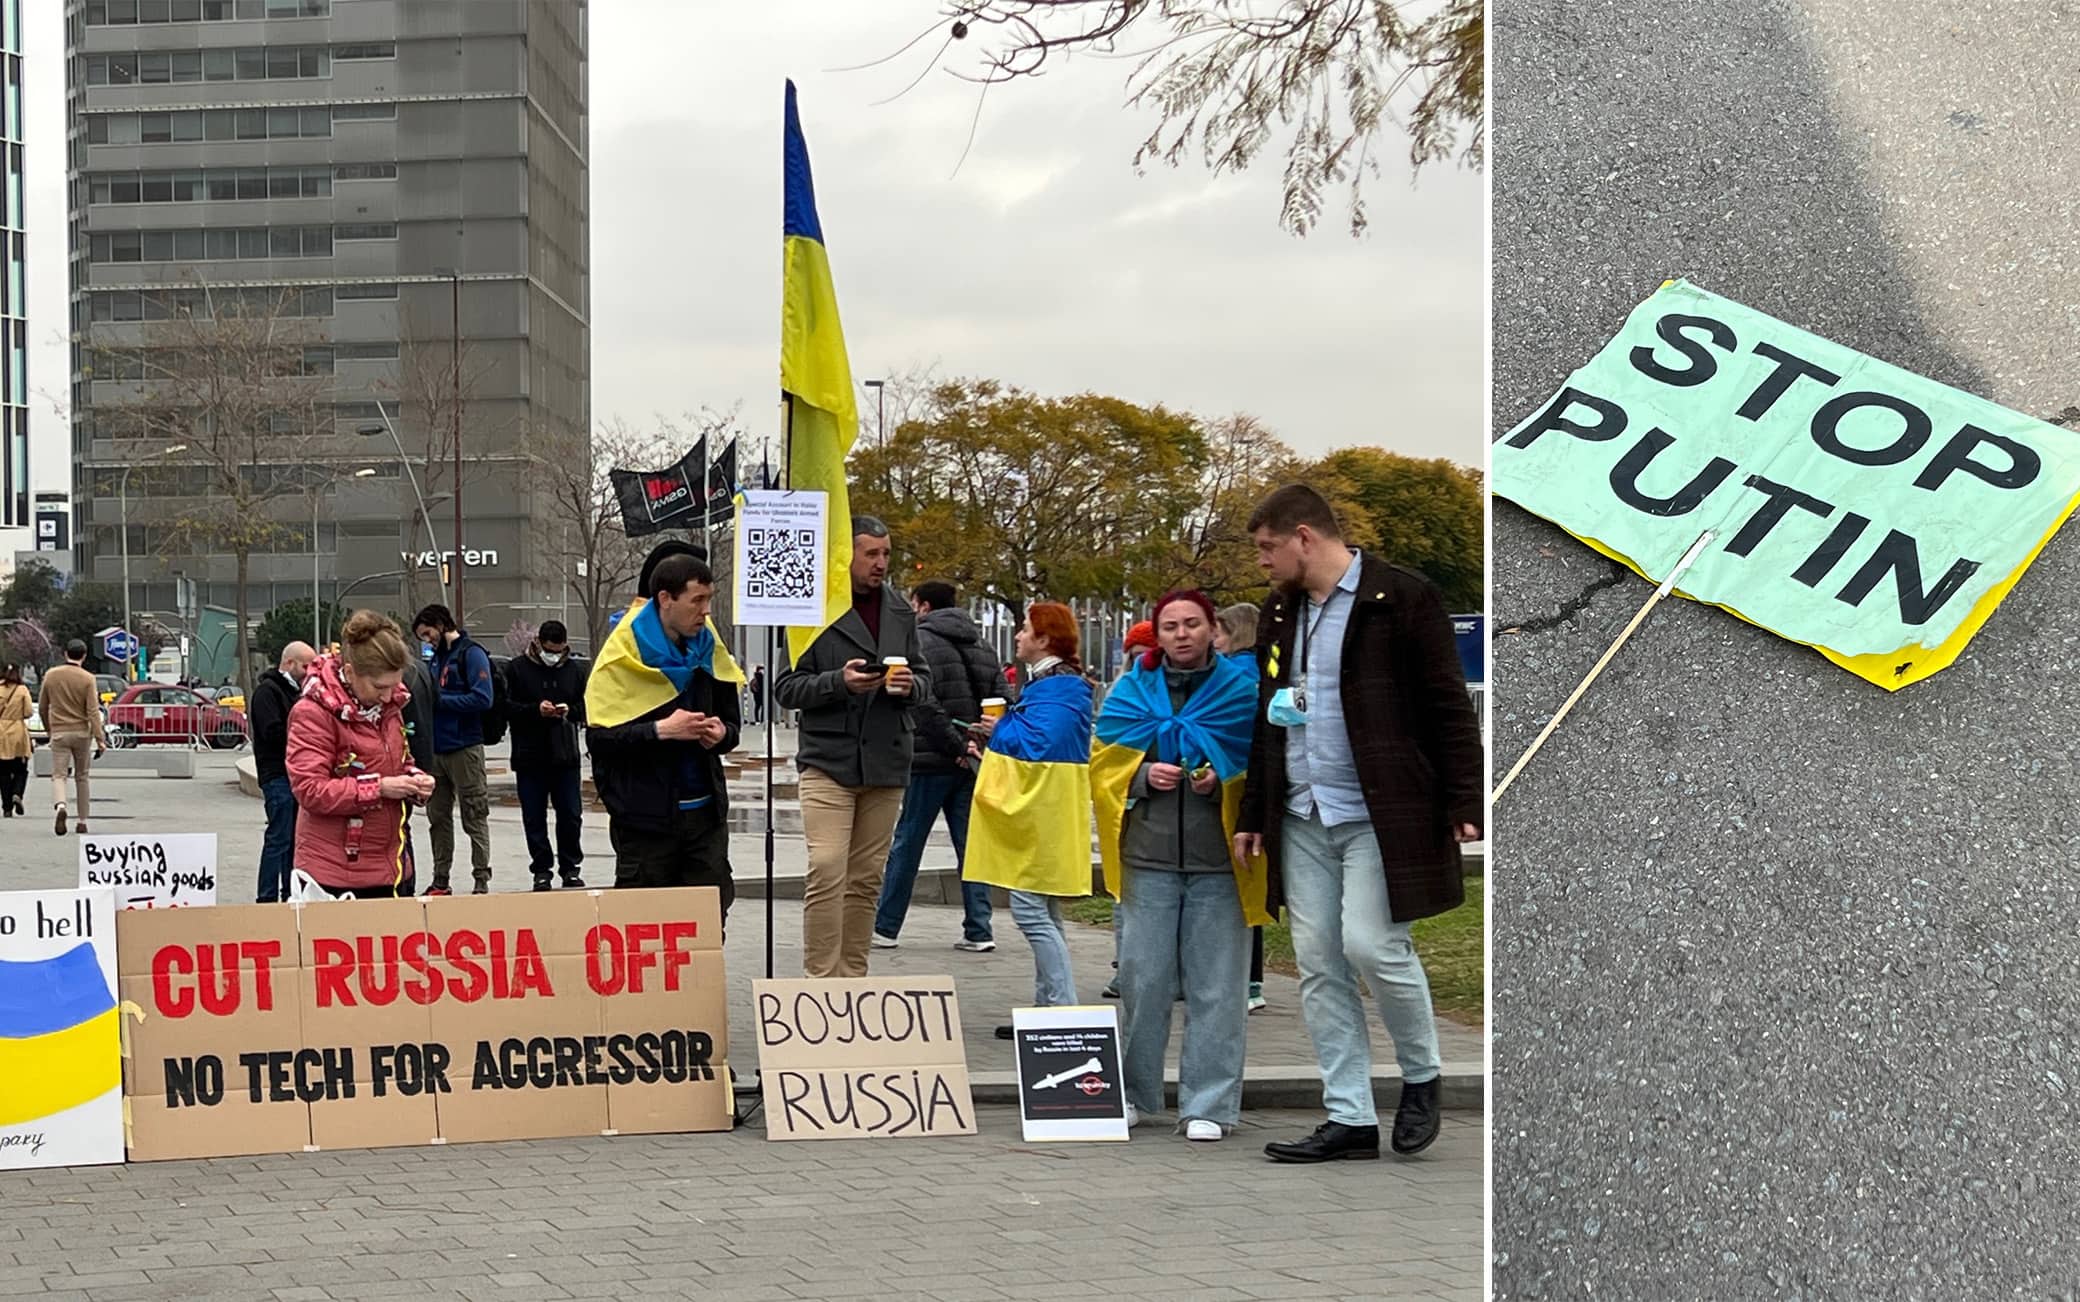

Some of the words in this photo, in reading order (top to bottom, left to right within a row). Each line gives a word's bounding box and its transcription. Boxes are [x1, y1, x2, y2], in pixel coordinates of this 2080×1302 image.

[1629, 313, 2042, 491] STOP
[1505, 387, 1982, 625] PUTIN
[85, 841, 167, 873] Buying
[171, 867, 214, 897] goods
[37, 898, 92, 938] hell
[152, 940, 280, 1018] CUT
[313, 929, 555, 1008] RUSSIA
[585, 922, 697, 996] OFF
[759, 991, 953, 1045] BOYCOTT
[163, 1055, 224, 1107] NO
[240, 1047, 356, 1103] TECH
[370, 1043, 451, 1097] FOR
[472, 1030, 714, 1090] AGGRESSOR
